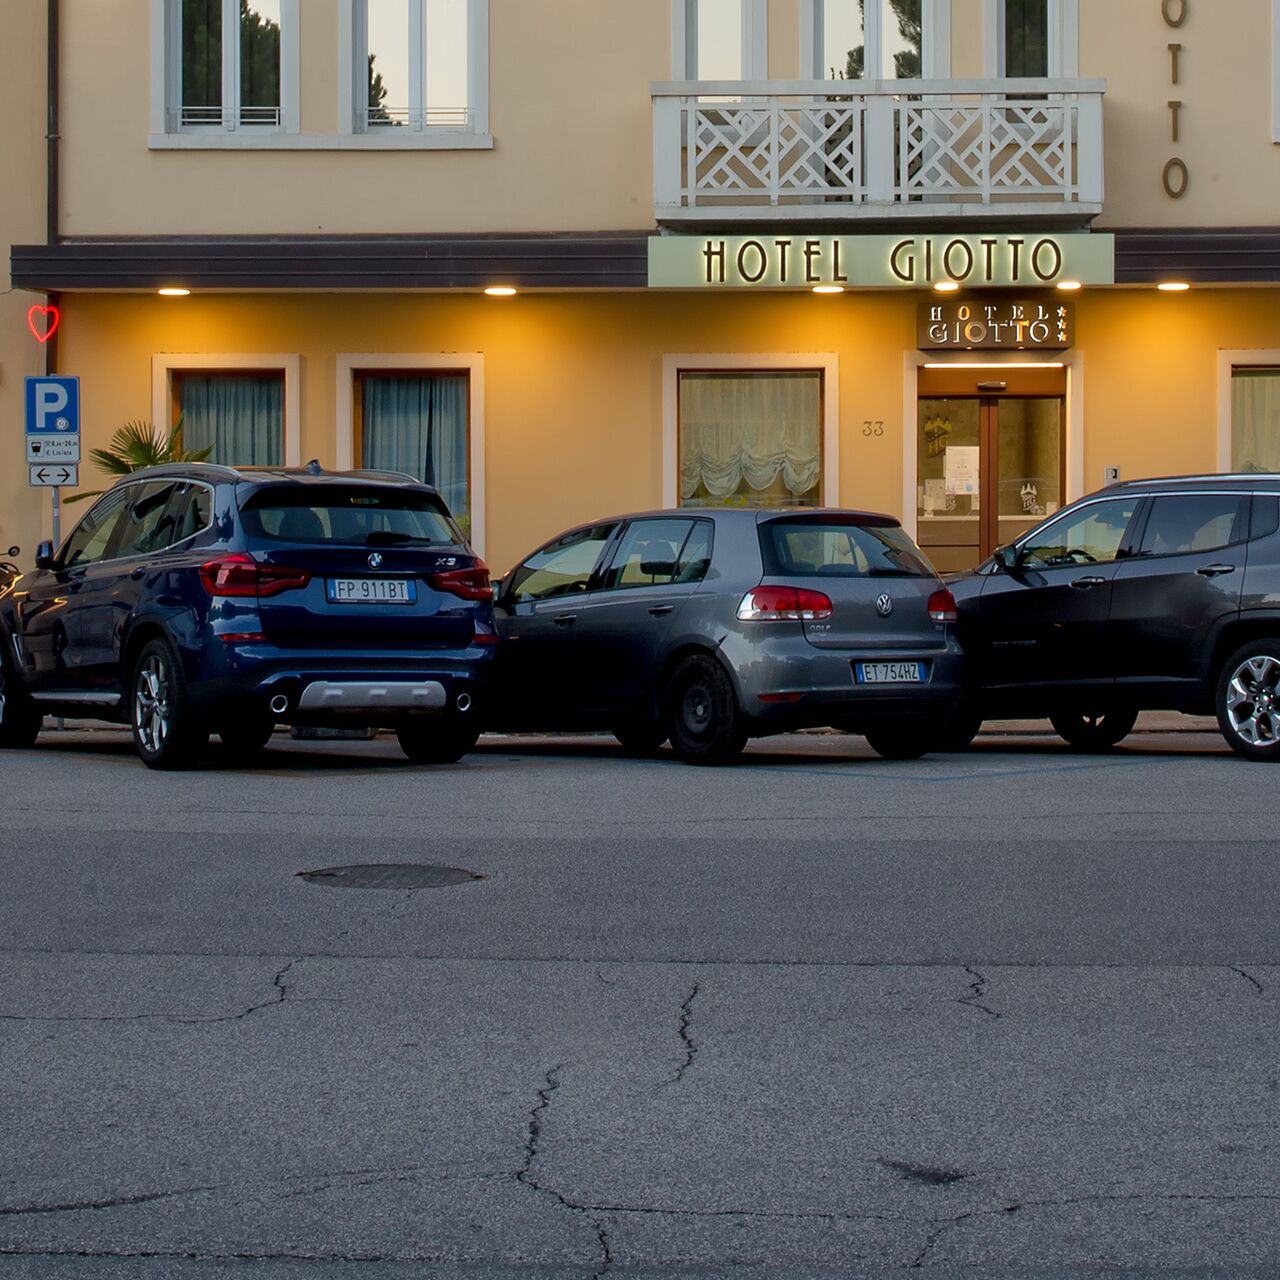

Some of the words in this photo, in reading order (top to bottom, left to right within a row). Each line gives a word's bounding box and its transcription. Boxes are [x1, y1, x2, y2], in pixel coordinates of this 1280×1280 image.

[702, 239, 848, 282] HOTEL
[889, 238, 1062, 282] GIOTTO
[929, 305, 1050, 321] HOTEL
[927, 320, 1051, 343] GIOTTO
[35, 383, 69, 428] P
[862, 421, 884, 436] 33
[434, 557, 457, 566] X3
[338, 581, 356, 597] FP
[360, 581, 406, 598] 911BT
[864, 665, 880, 681] ET
[883, 663, 919, 681] 754HZ
